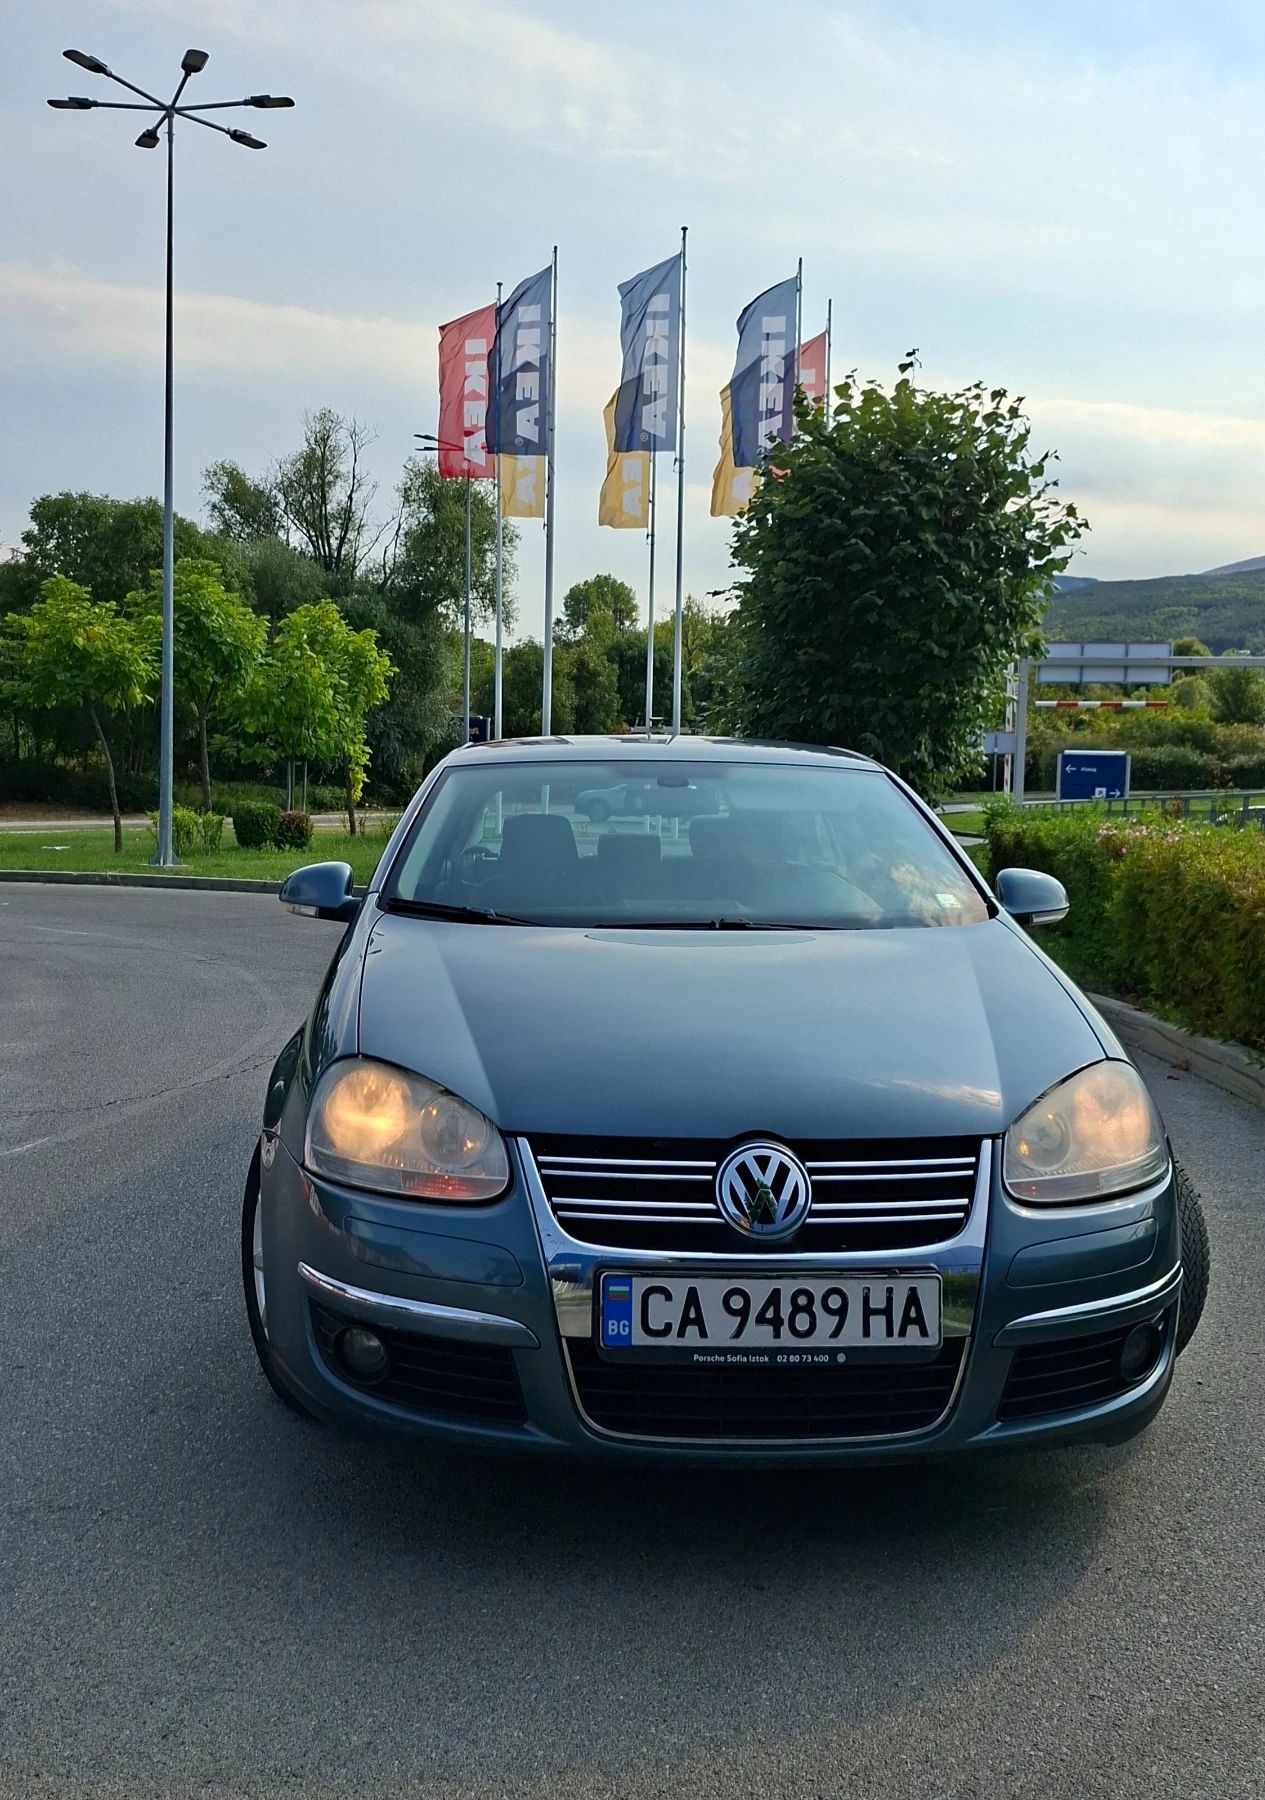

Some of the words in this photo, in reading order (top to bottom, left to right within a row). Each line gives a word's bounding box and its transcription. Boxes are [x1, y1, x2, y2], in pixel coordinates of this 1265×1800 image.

[640, 1285, 709, 1339] CA
[722, 1286, 850, 1340] 9489
[862, 1285, 930, 1339] HA
[608, 1319, 630, 1336] BG
[693, 1354, 725, 1362] Porsche
[726, 1354, 748, 1363] Sofia
[749, 1355, 770, 1363] Iztok
[776, 1355, 788, 1363] 02
[789, 1355, 800, 1363] 80
[801, 1355, 812, 1363] 73
[813, 1355, 830, 1363] 400
